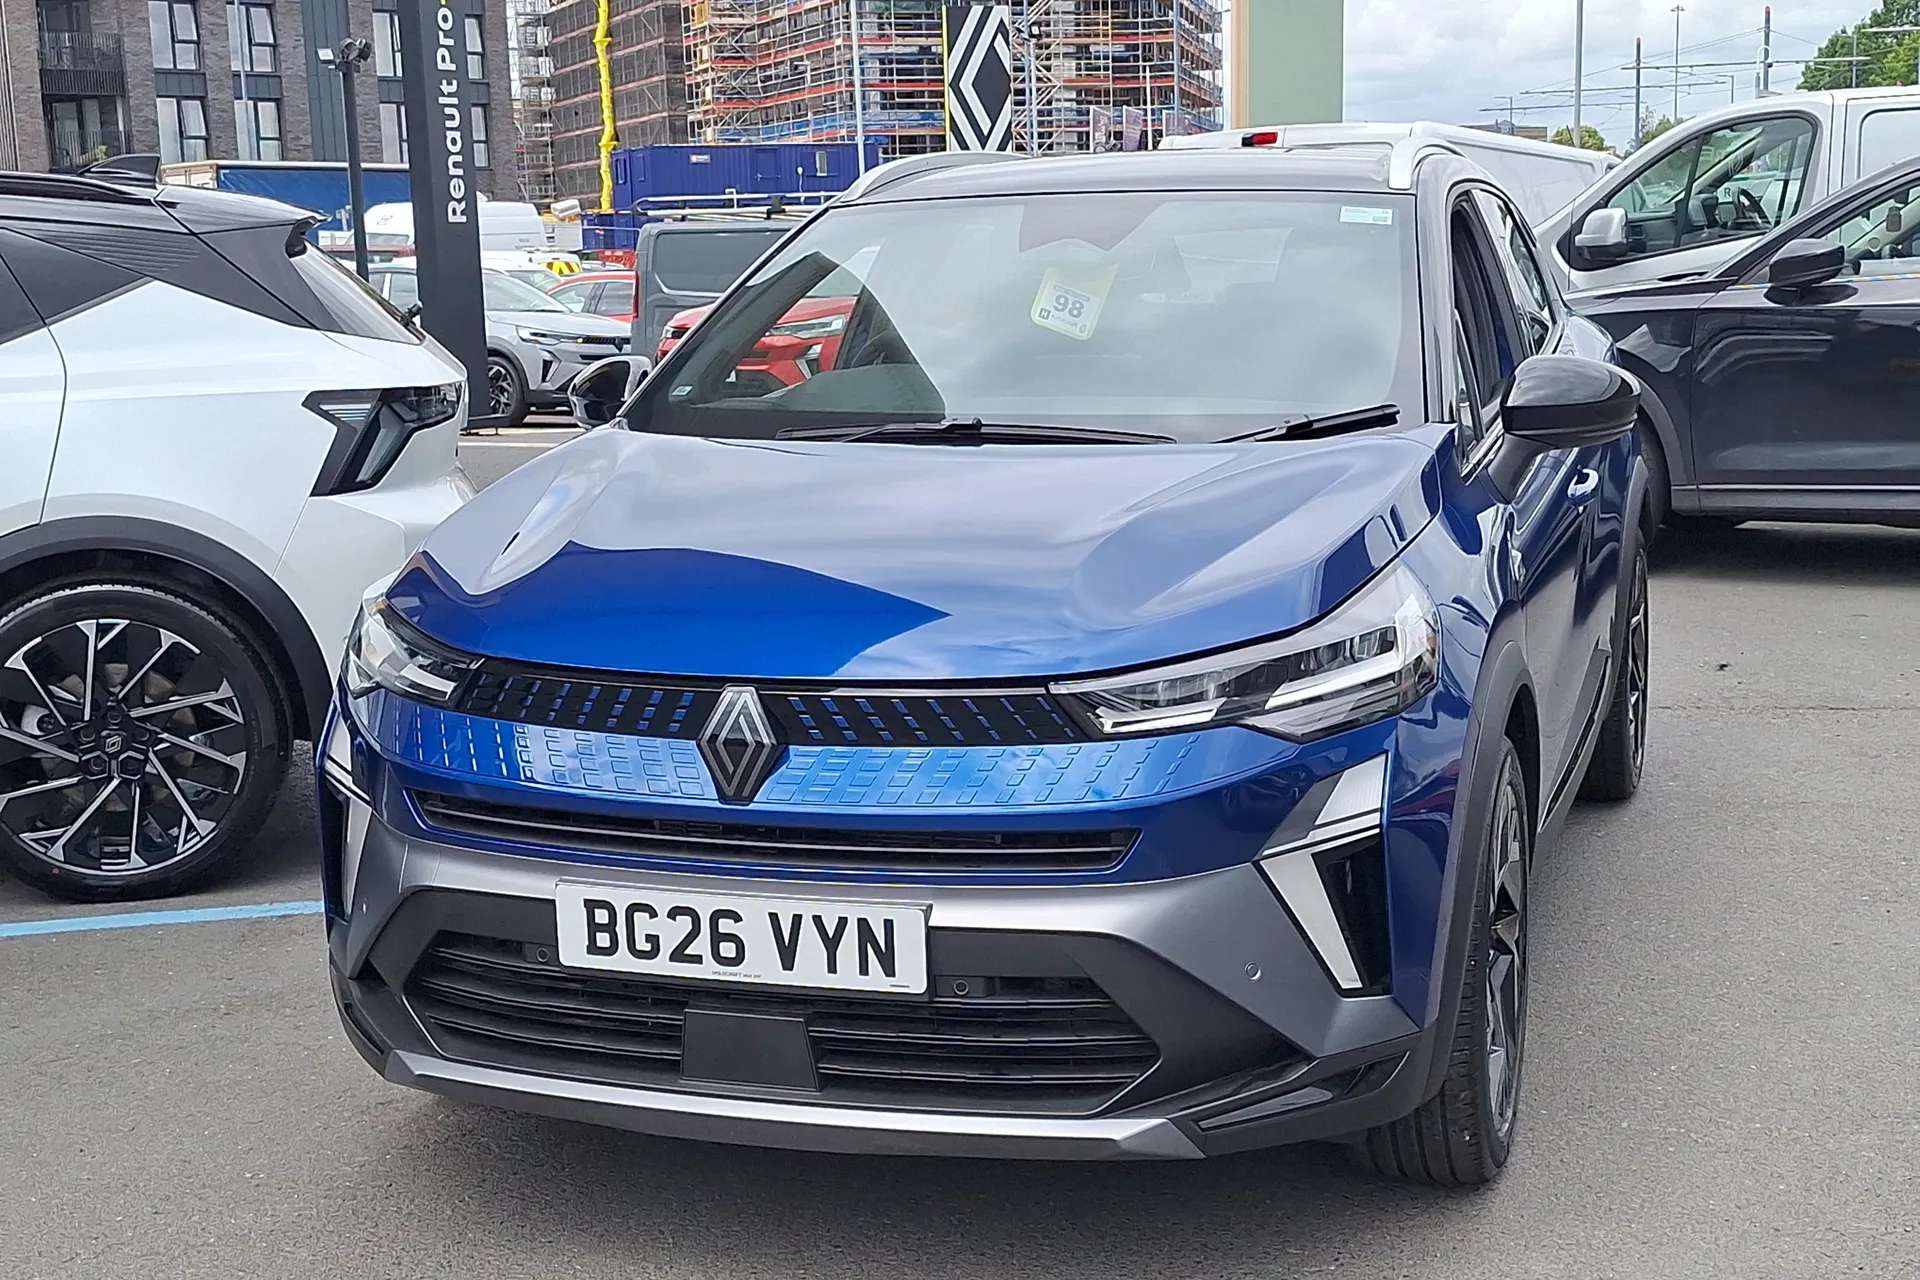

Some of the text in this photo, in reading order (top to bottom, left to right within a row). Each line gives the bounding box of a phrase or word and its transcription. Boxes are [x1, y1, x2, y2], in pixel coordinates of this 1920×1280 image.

[438, 79, 467, 223] Renault
[1053, 294, 1085, 319] 98
[583, 898, 896, 978] BG26 VYN
